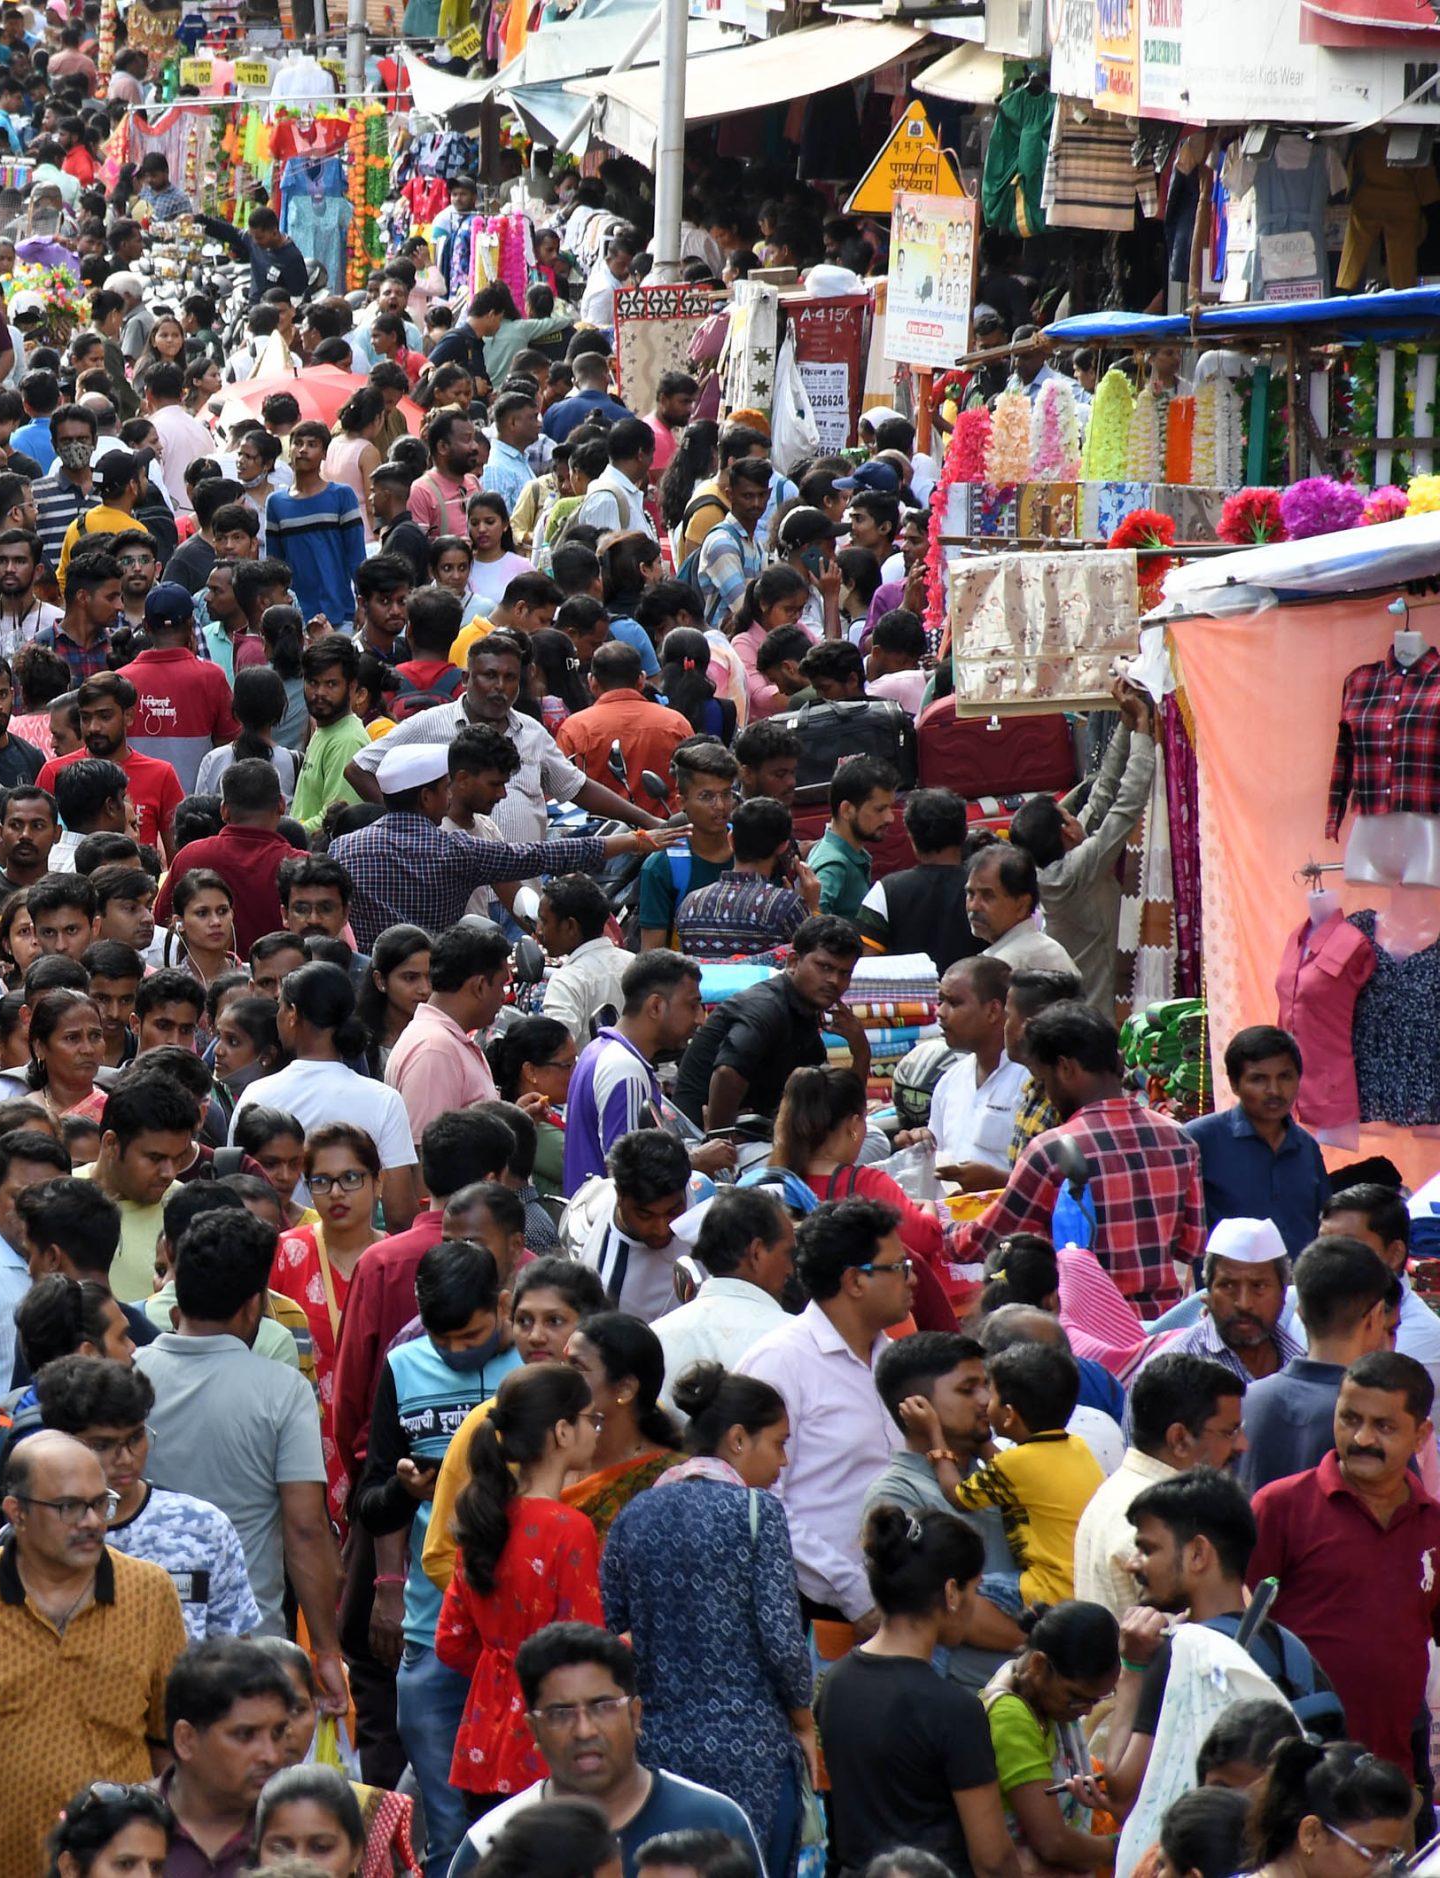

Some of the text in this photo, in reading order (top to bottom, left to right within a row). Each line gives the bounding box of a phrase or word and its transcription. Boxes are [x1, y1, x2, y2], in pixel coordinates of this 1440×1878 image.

[235, 62, 267, 71] T-SHIRTS
[247, 73, 266, 84] 100
[1258, 65, 1278, 86] Kids
[1280, 66, 1304, 87] Wear
[1267, 239, 1306, 255] SCHOOL
[1266, 285, 1318, 295] EXCELSIOR
